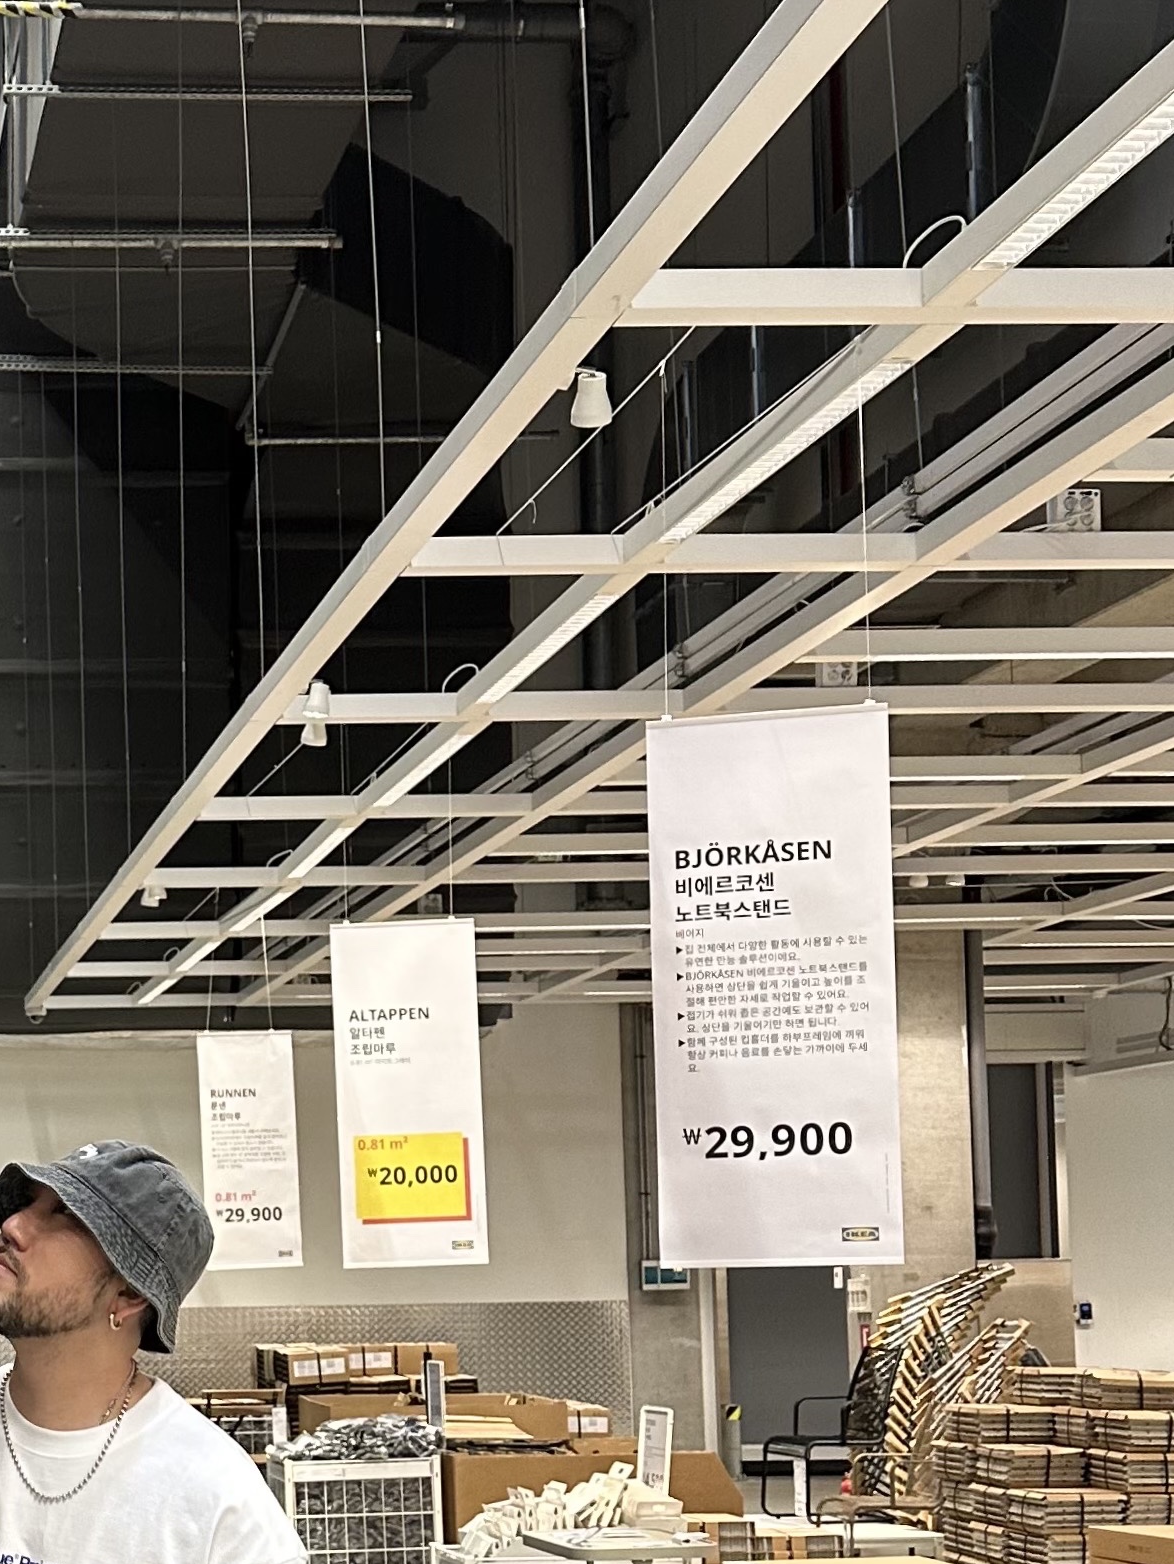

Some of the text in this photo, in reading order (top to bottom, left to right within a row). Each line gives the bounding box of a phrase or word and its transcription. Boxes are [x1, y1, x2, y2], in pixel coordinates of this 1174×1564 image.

[675, 839, 832, 869] BJÖRKÅSEN
[675, 872, 775, 897] 비에르코센
[675, 899, 792, 922] 노트북스탠드
[676, 928, 704, 939] 베이지
[738, 940, 767, 951] 다양한
[835, 935, 844, 946] 수
[848, 934, 867, 945] 있는
[685, 961, 867, 981] BJÖRKÅSEN 비에르코센 노트북스탠드를
[856, 975, 866, 985] 조
[804, 991, 813, 1001] 수
[349, 1007, 430, 1023] ALTAPPEN
[686, 1010, 714, 1021] 접기가
[837, 1003, 846, 1014] 수
[849, 1002, 869, 1013] 있어
[350, 1043, 397, 1056] 조립마루
[848, 1041, 868, 1052] 두세
[210, 1088, 256, 1098] RUNNEN
[358, 1136, 409, 1151] 0.81 m²
[215, 1190, 256, 1202] 0.81 m²
[843, 1229, 878, 1239] IKEA
